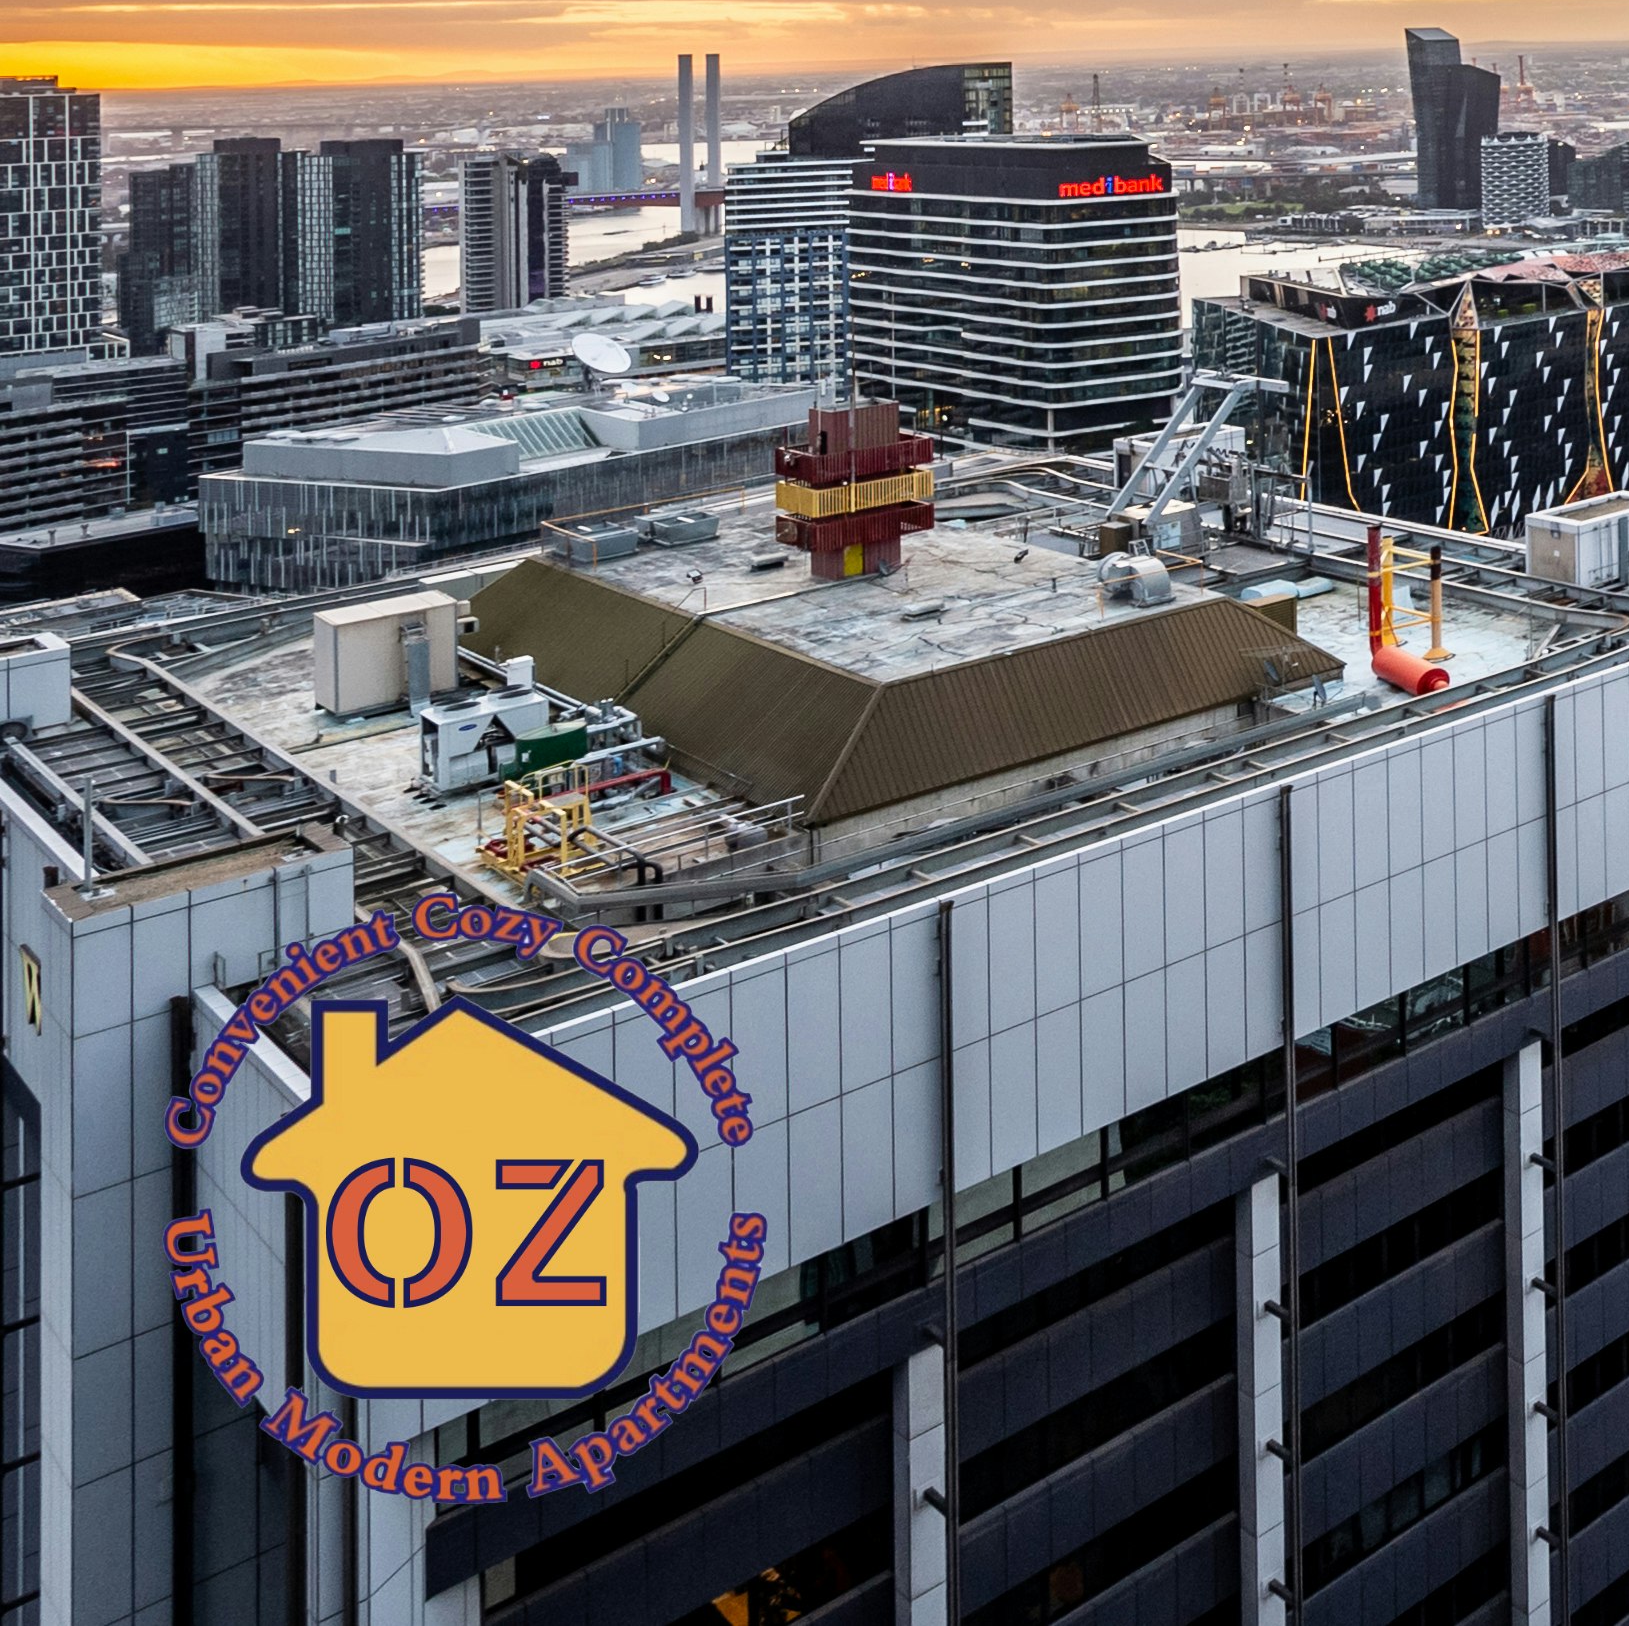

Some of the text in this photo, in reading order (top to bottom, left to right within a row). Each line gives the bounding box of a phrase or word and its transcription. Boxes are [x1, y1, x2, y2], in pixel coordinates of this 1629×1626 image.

[1059, 173, 1164, 198] medibank
[1377, 300, 1396, 316] nab
[542, 357, 564, 367] nab
